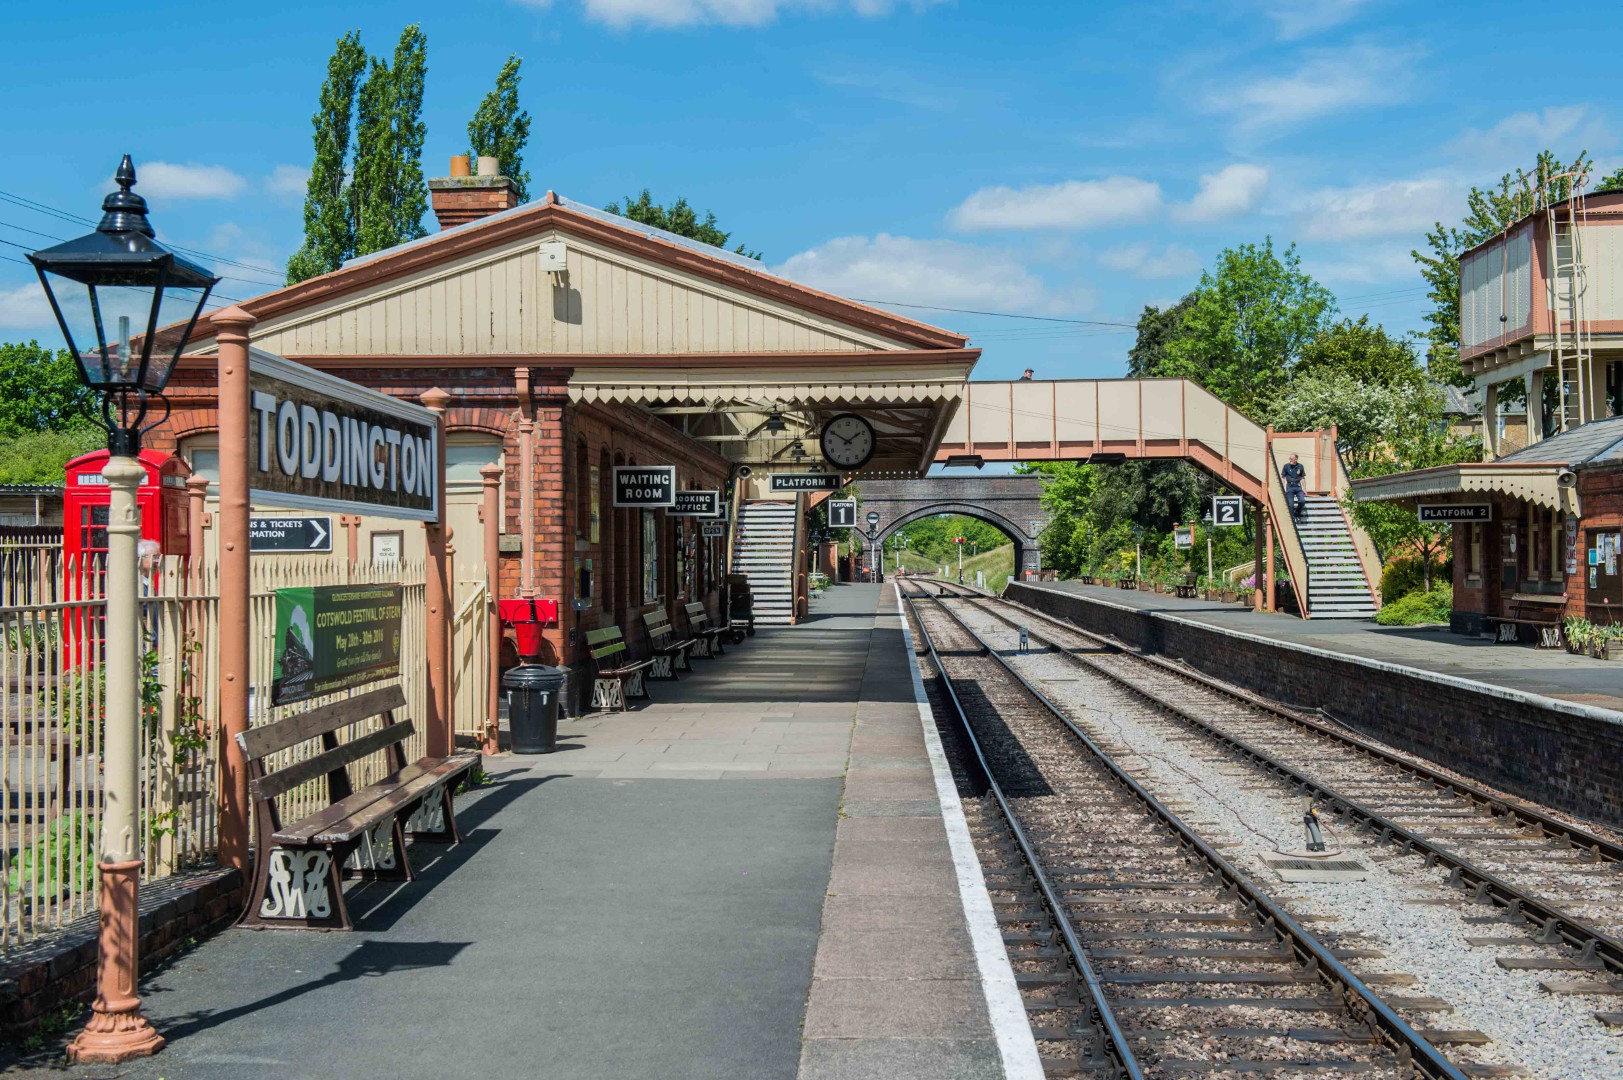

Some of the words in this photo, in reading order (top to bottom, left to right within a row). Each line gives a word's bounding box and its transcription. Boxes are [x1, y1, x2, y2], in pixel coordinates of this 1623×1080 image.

[253, 390, 431, 498] TODDINGTON
[619, 474, 670, 485] WAITING
[776, 478, 826, 487] PLATFORM
[625, 488, 662, 499] ROOM
[839, 508, 845, 523] 1
[1222, 506, 1234, 521] 2
[1424, 508, 1474, 517] PLATFORM
[1480, 508, 1487, 516] 2
[269, 520, 303, 528] TICKETS
[317, 611, 352, 627] COTSWOLD
[353, 607, 378, 623] FESTIVAL
[379, 607, 385, 620] OF
[336, 635, 347, 651] May
